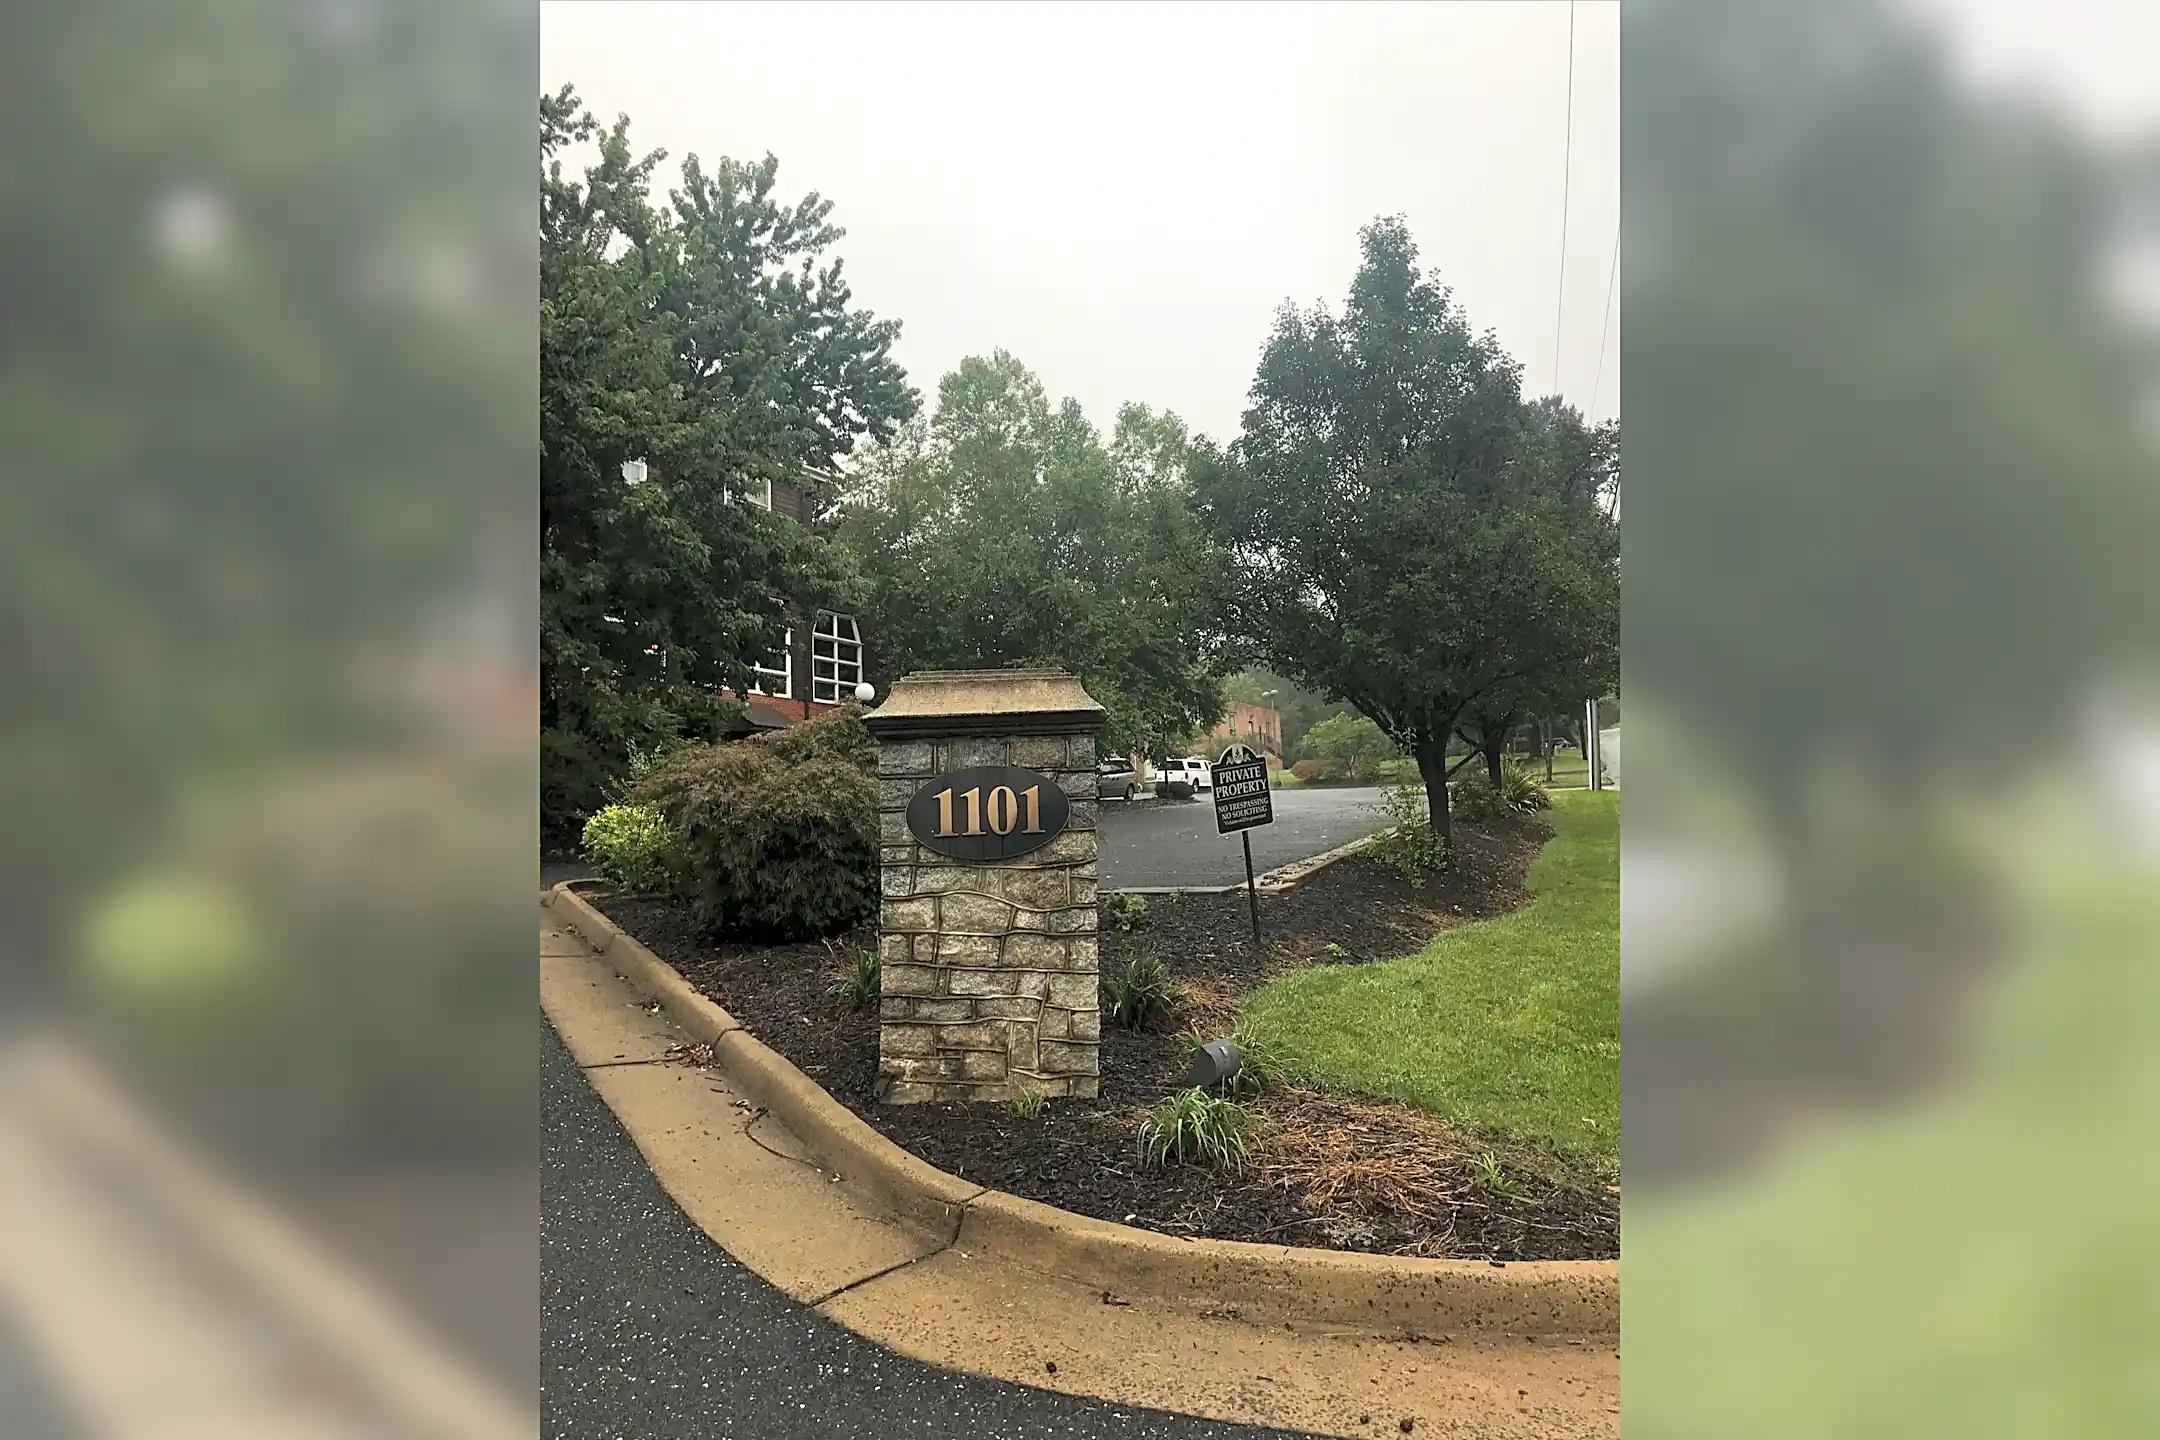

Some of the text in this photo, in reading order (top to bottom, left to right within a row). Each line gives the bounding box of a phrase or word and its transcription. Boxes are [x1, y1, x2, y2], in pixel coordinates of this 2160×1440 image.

[1219, 766, 1261, 784] PRIVATE
[1215, 778, 1266, 798] PROPERTY
[932, 785, 1046, 838] 1101
[1218, 797, 1268, 814] NO TRESPASSING
[1221, 812, 1232, 820] NO
[1232, 805, 1267, 818] SOLICITING
